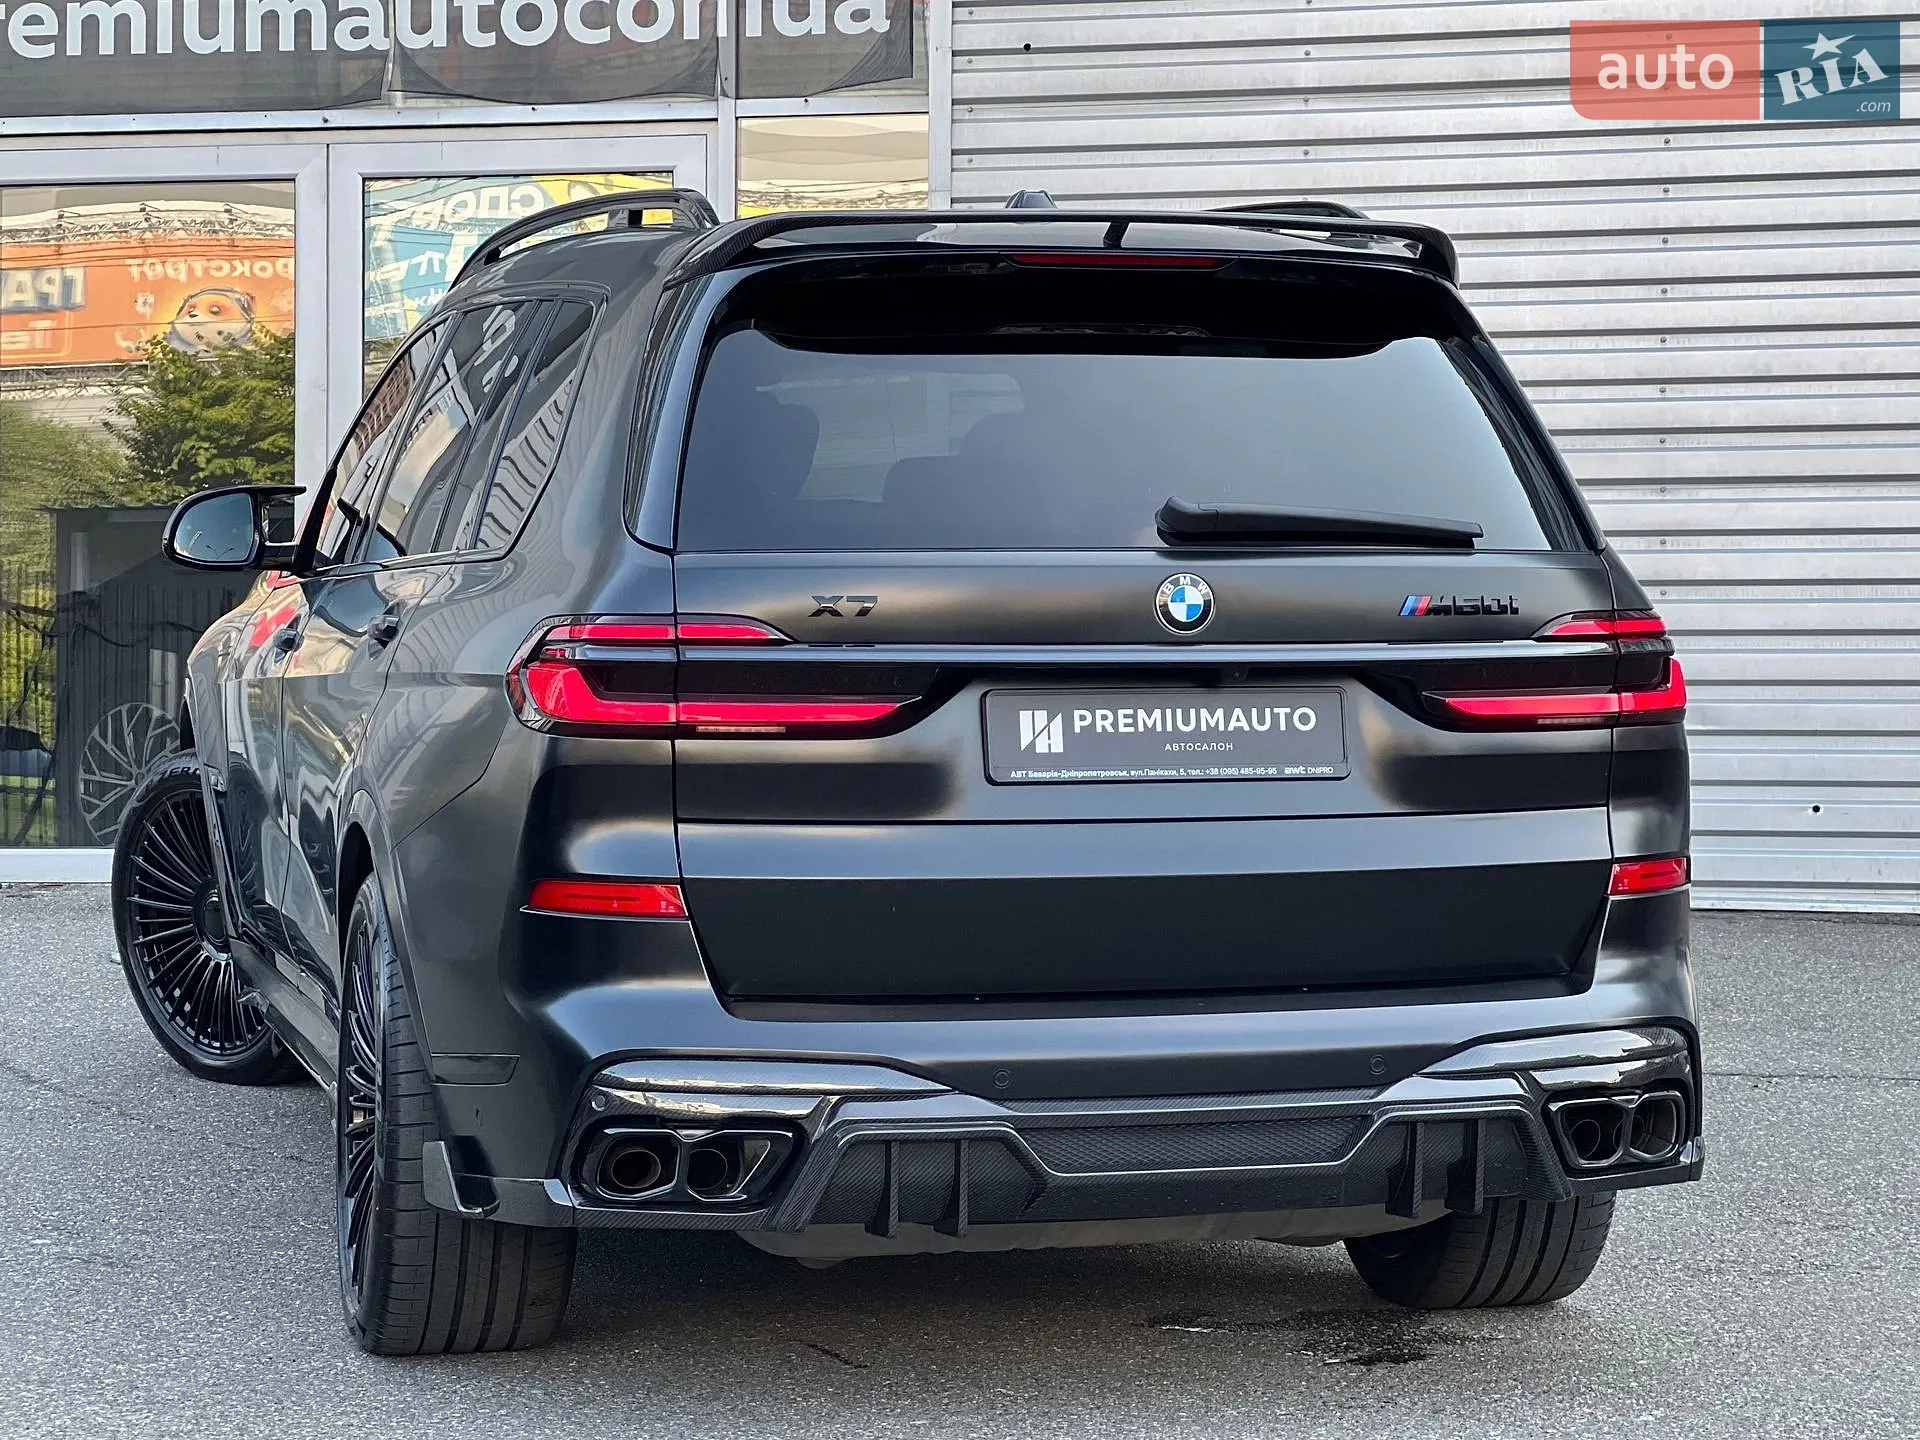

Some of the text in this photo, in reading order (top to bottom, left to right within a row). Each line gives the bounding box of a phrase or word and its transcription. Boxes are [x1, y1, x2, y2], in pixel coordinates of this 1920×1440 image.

[1162, 575, 1209, 595] BMW
[808, 595, 879, 618] X7
[1073, 706, 1318, 734] PREMIUMAUTO
[1164, 742, 1234, 752] АВТОСАЛОН
